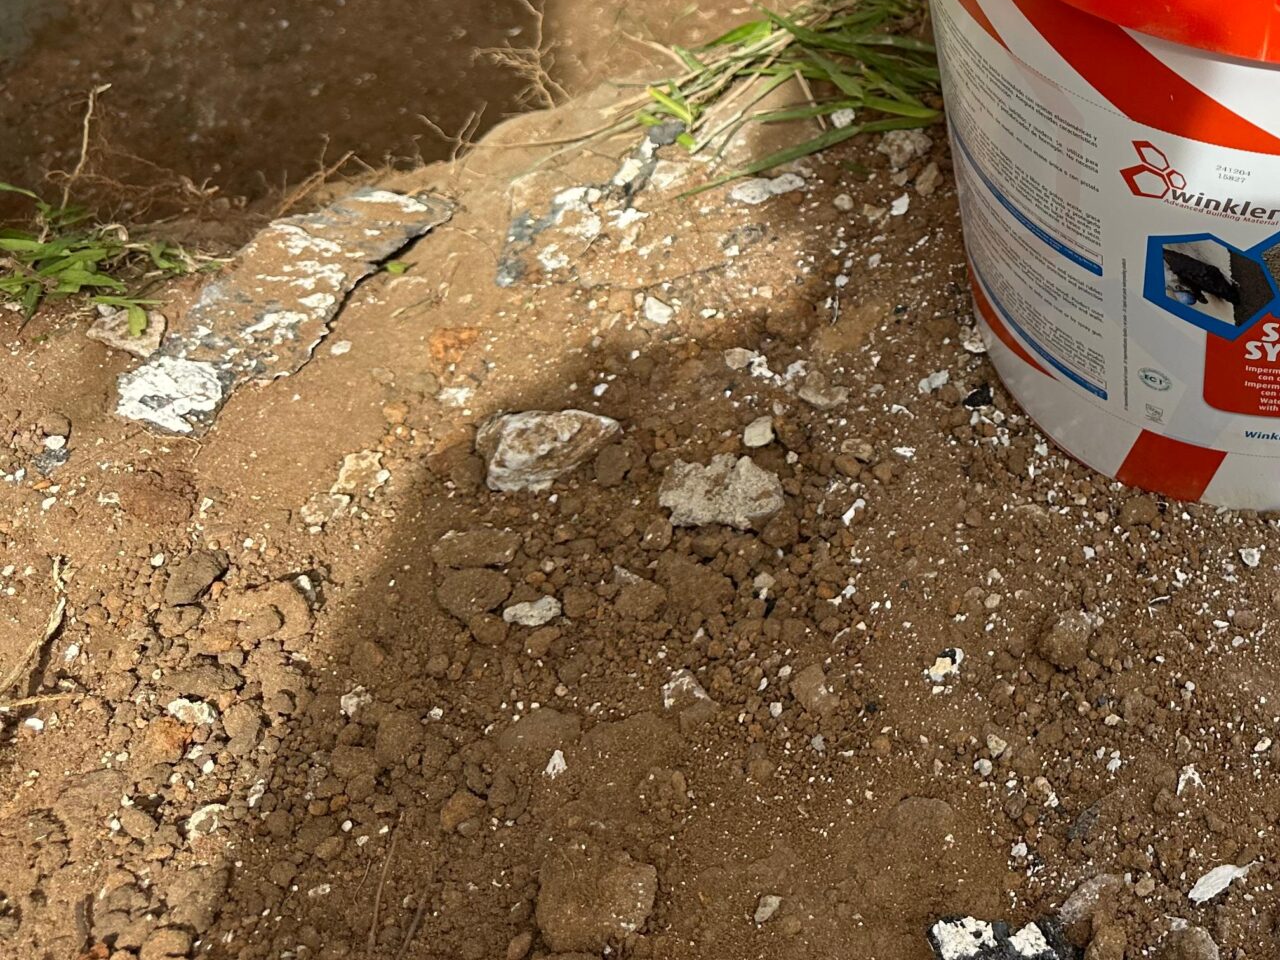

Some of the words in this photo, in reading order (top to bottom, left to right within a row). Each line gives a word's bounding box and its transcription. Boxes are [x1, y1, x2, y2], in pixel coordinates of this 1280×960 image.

[1001, 74, 1024, 97] formulado
[1025, 95, 1034, 103] con
[1054, 114, 1092, 139] elastoméricas
[1059, 124, 1098, 148] características
[1067, 147, 1084, 160] utiliza
[1086, 157, 1099, 168] para
[1076, 158, 1099, 174] necesita
[1081, 180, 1100, 193] pistola
[1163, 198, 1204, 214] Advanced
[1206, 209, 1241, 222] Building
[1242, 216, 1279, 226] Material
[1093, 228, 1101, 236] de
[1067, 273, 1085, 288] special
[1258, 404, 1279, 412] with
